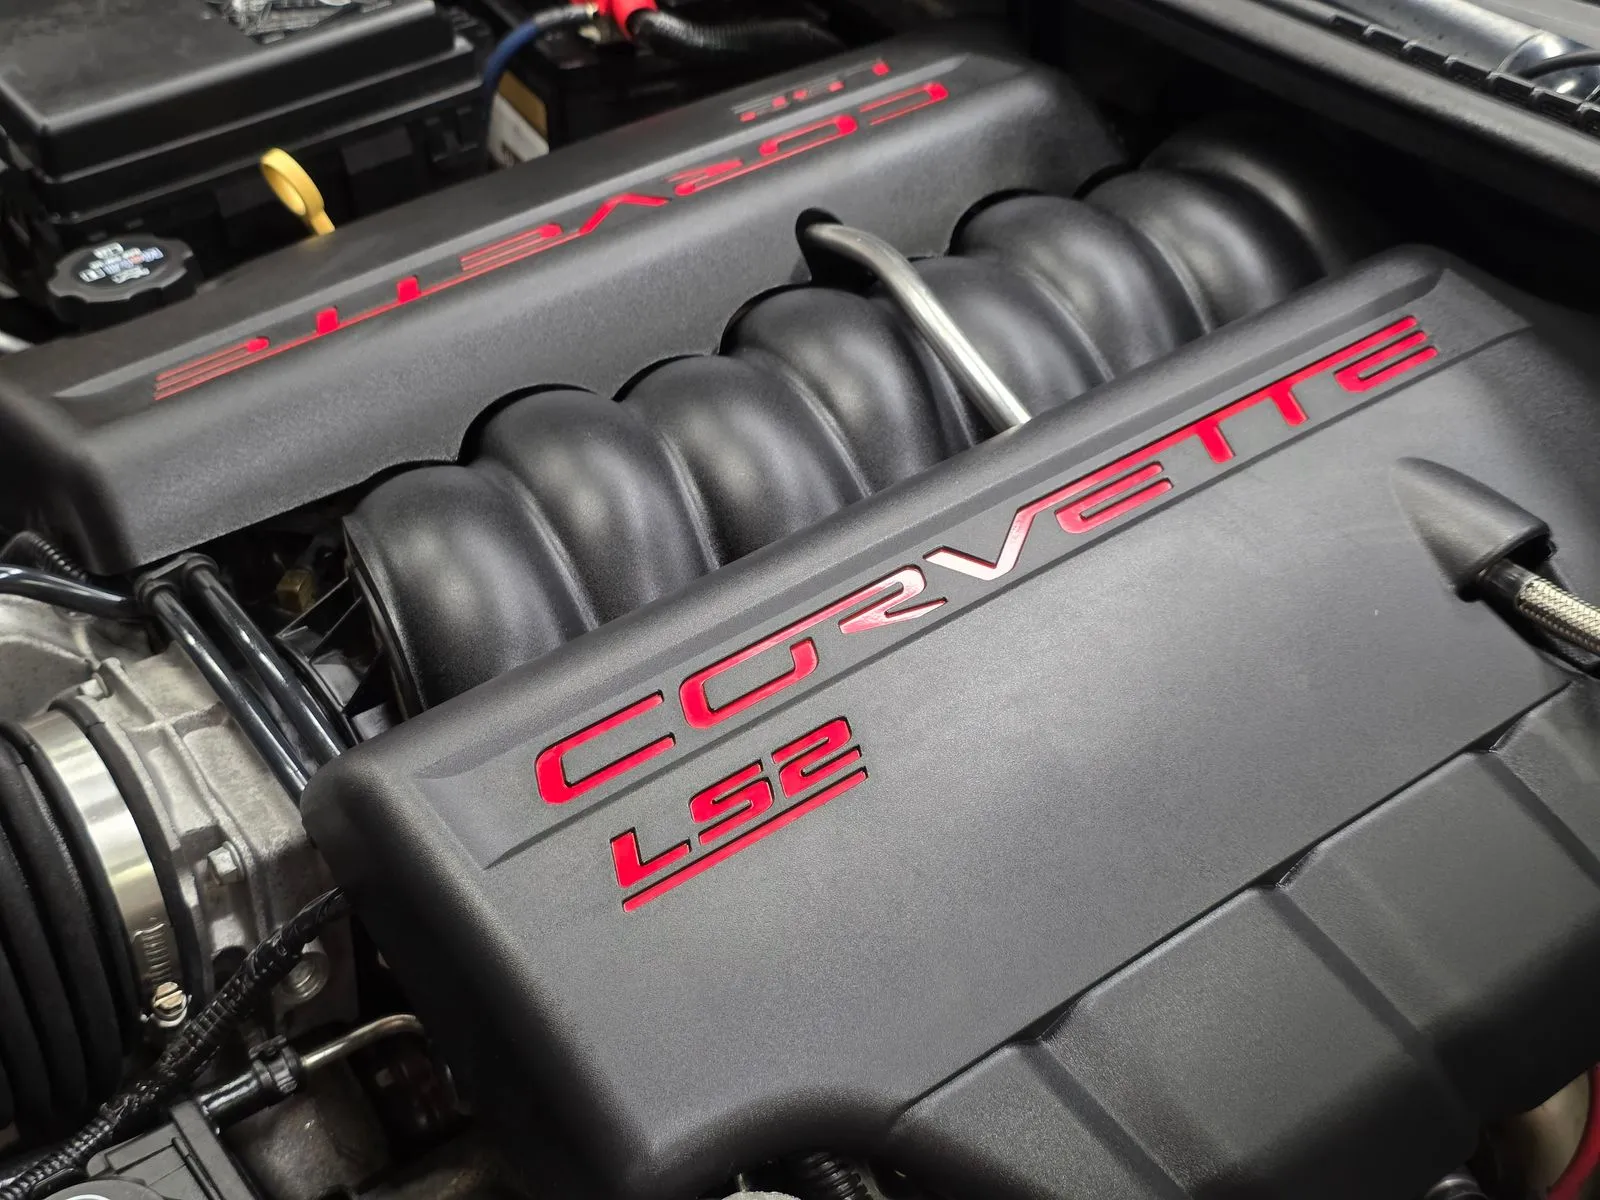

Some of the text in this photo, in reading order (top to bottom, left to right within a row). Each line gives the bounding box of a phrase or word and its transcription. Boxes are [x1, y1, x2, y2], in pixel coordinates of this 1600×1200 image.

[153, 81, 950, 401] CORVETTE
[534, 315, 1439, 806] CORVETTE
[609, 717, 862, 889] LS2
